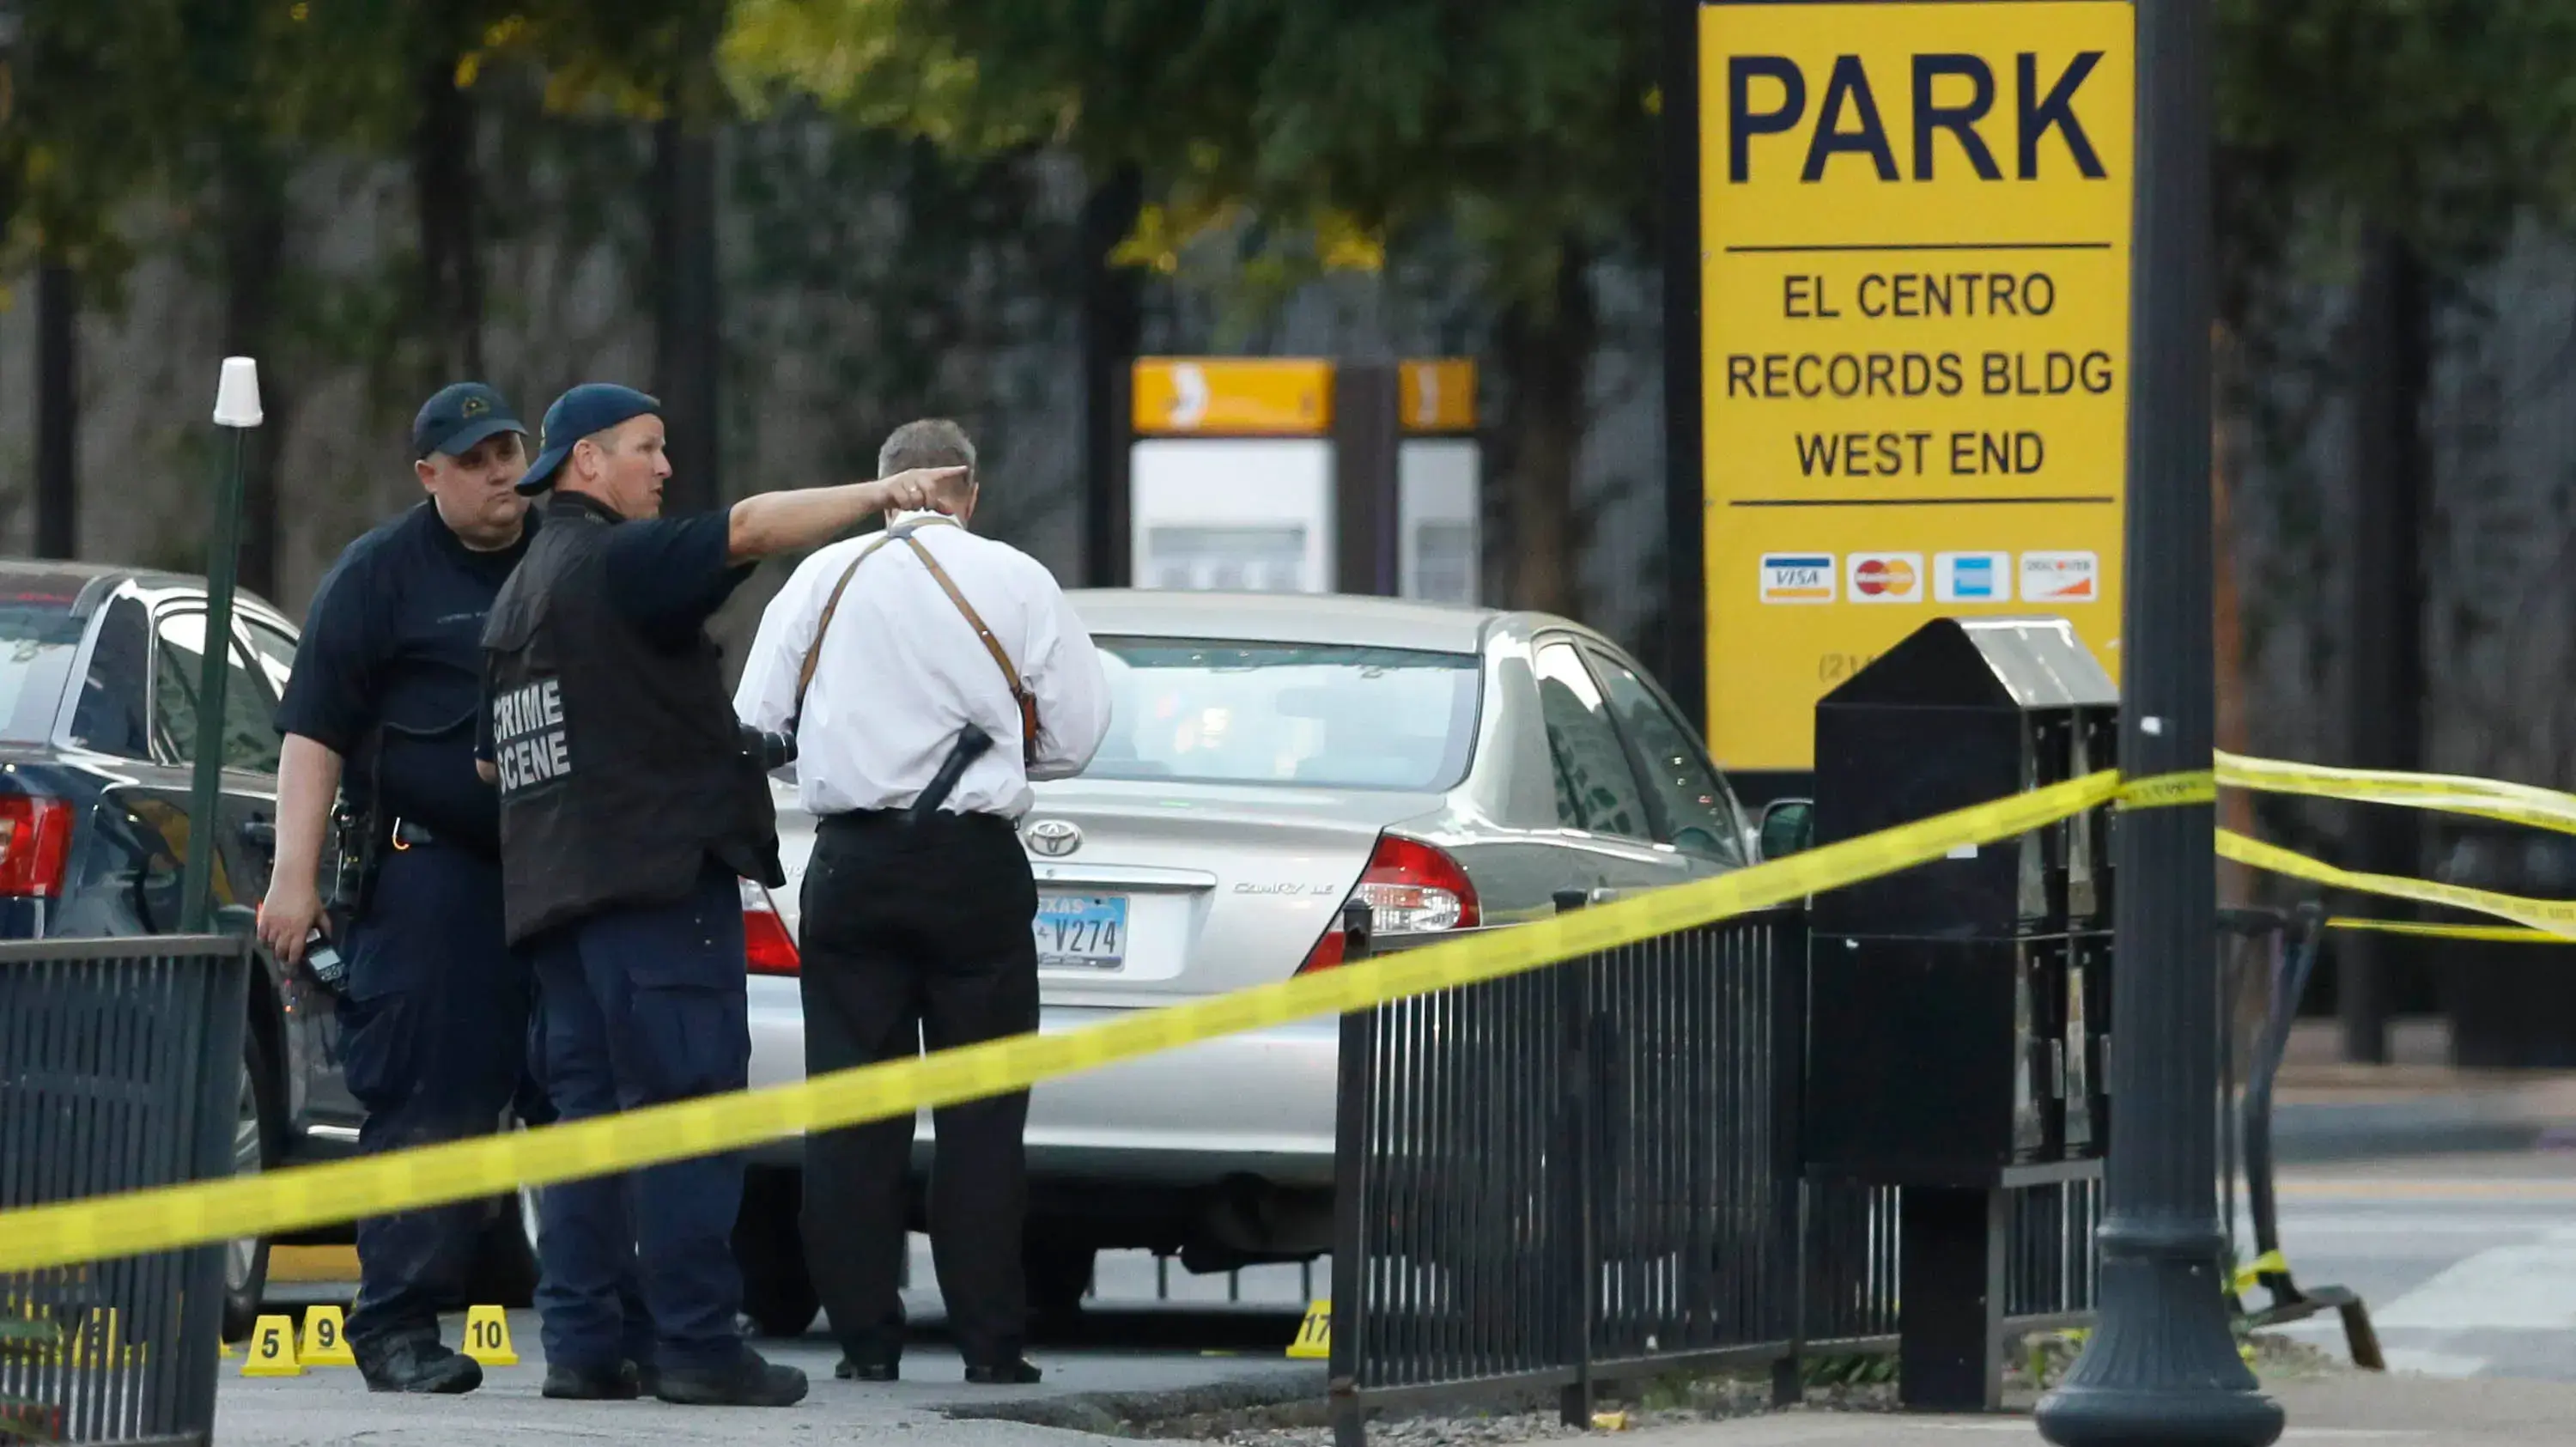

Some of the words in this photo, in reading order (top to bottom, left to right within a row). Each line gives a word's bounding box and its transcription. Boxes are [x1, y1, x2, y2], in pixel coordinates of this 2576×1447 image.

[1728, 51, 2108, 184] PARK
[1783, 274, 1840, 319] EL
[1857, 271, 2056, 319] CENTRO
[1727, 352, 1964, 398] RECORDS
[1982, 350, 2113, 396] BLDG
[1795, 432, 1932, 477] WEST
[1950, 431, 2044, 475] END
[1777, 569, 1818, 586] VISA
[494, 680, 563, 744] CRIME
[496, 731, 571, 795] SCENE
[1055, 918, 1116, 954] V274
[261, 1328, 280, 1359] 5
[317, 1318, 335, 1347] 9
[472, 1320, 502, 1349] 10
[1304, 1314, 1330, 1342] 17
